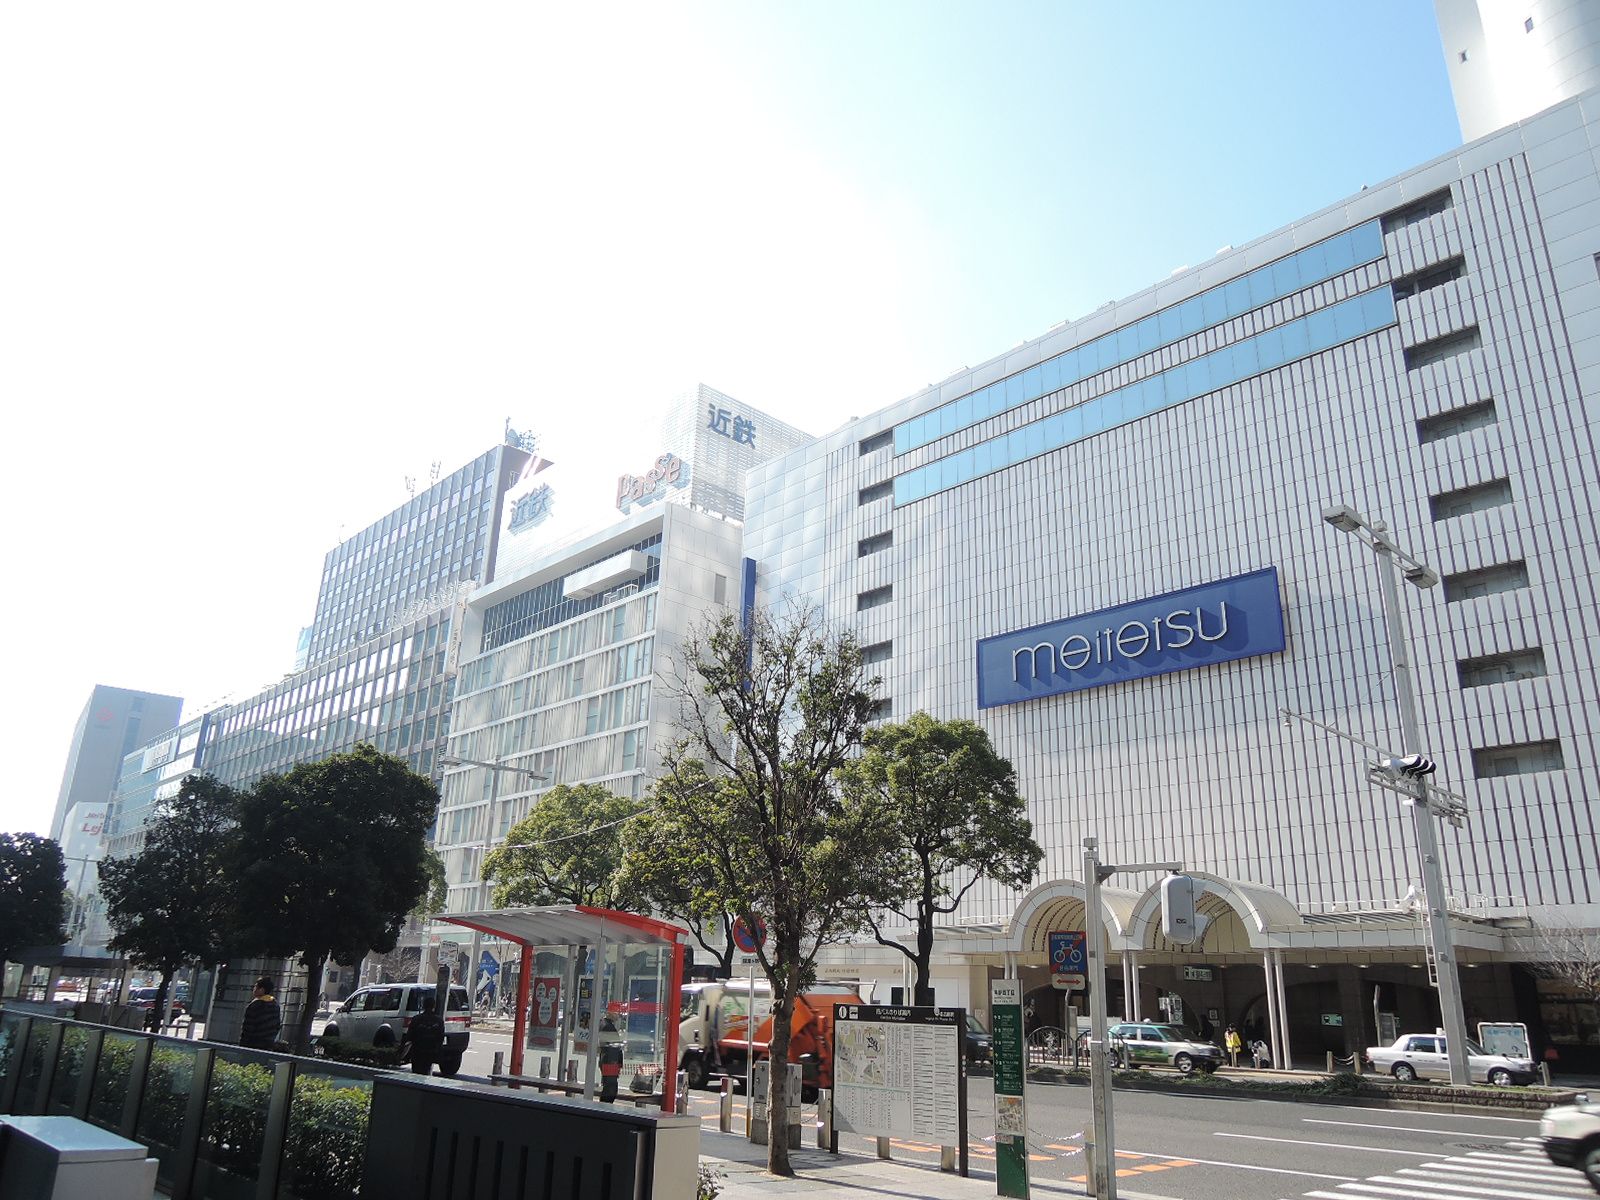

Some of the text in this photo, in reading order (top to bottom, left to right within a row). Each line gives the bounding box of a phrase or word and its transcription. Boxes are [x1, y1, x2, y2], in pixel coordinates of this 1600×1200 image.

[707, 403, 756, 449] 近鉄
[507, 482, 553, 530] 近鉄
[1012, 601, 1228, 682] meitetsu
